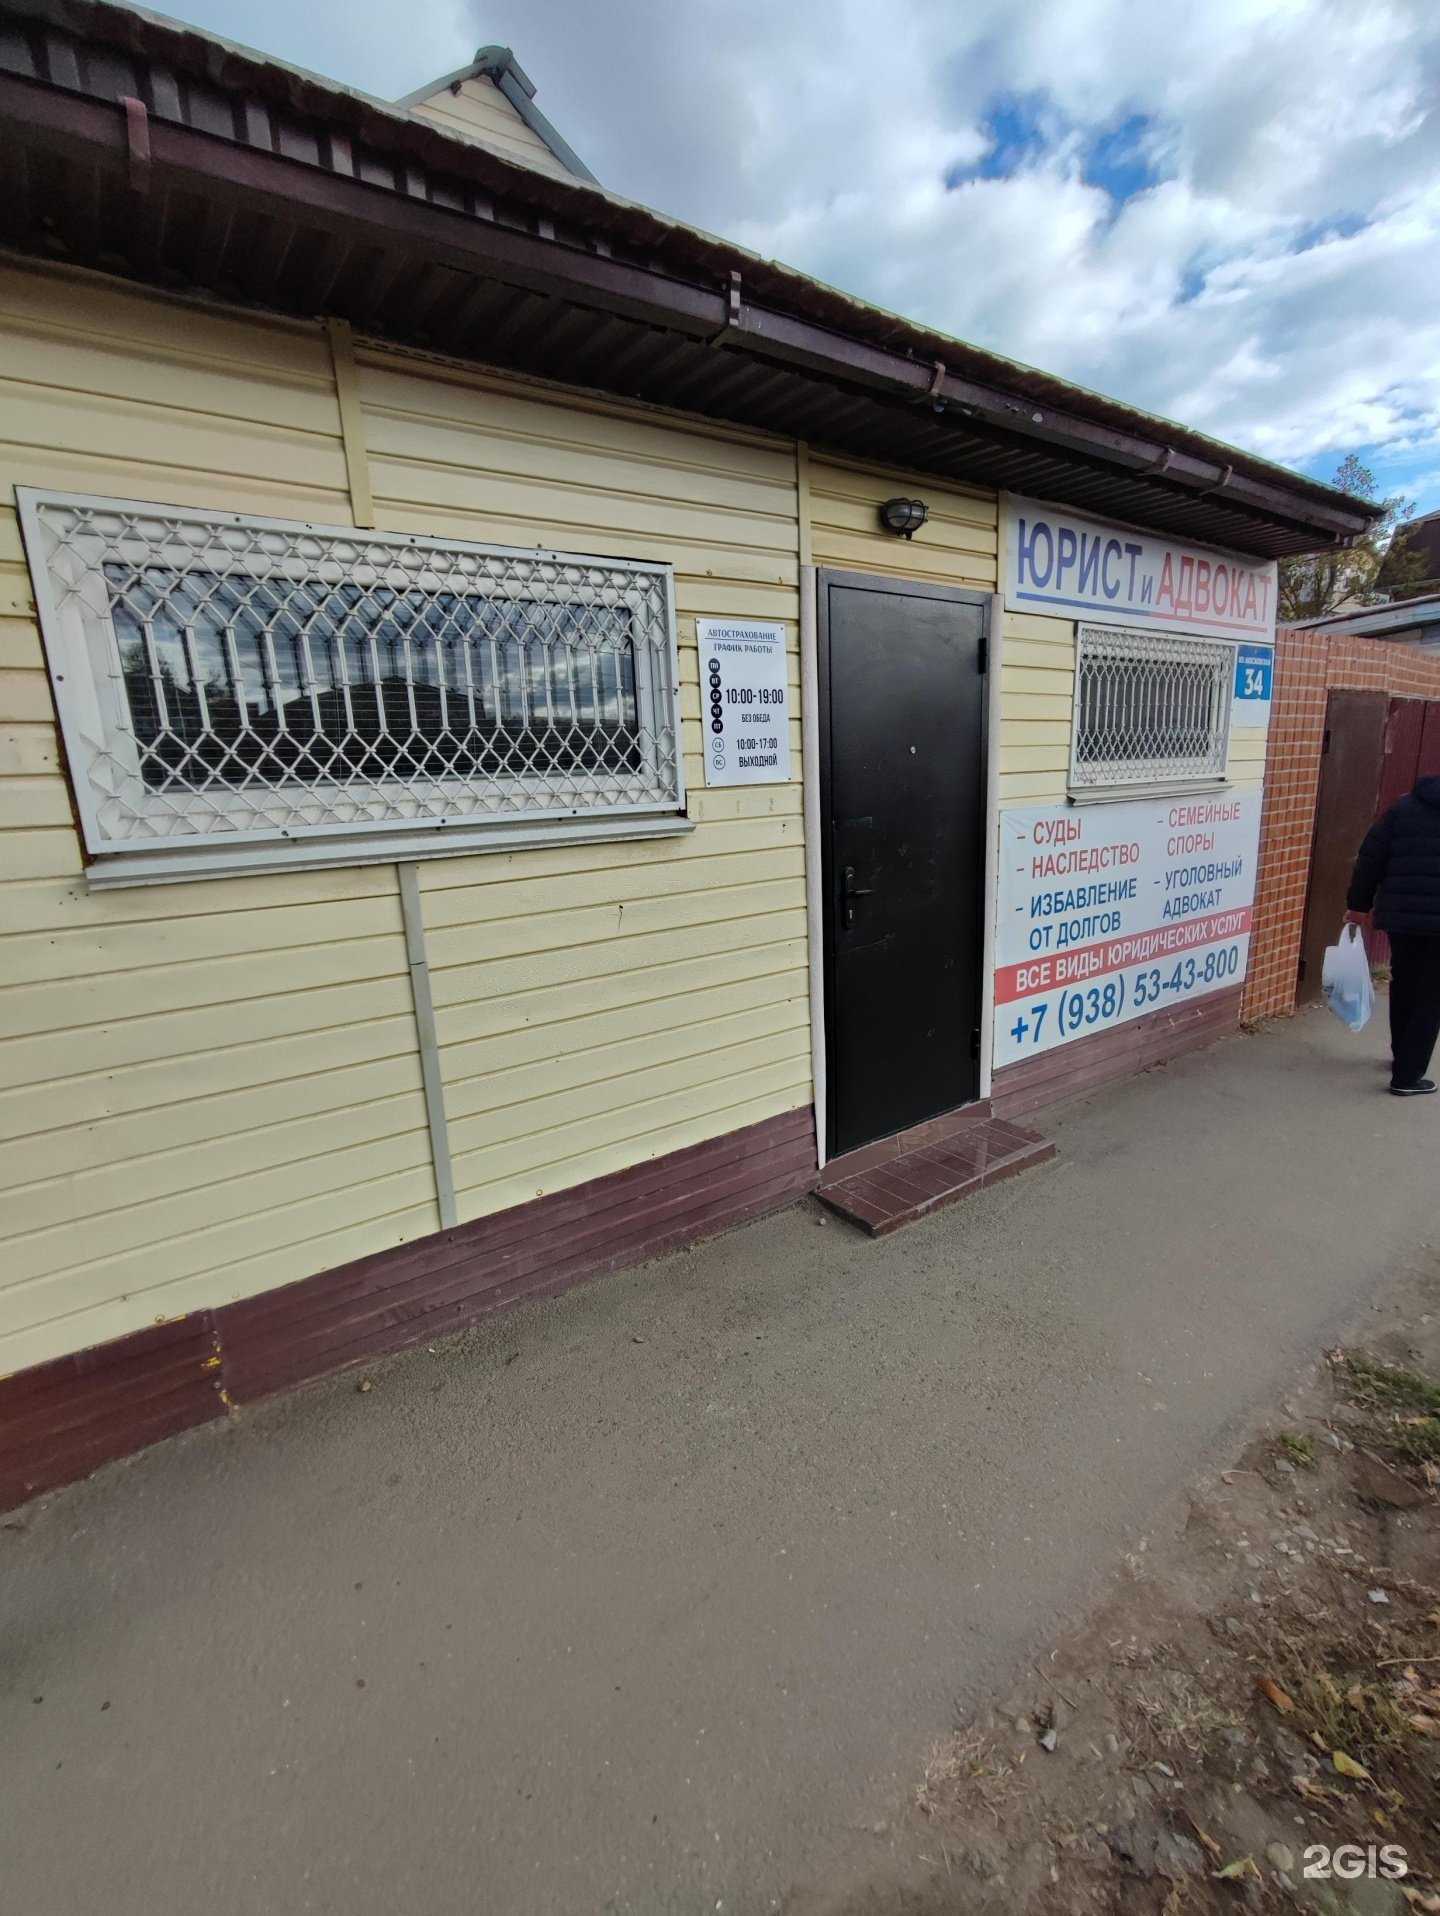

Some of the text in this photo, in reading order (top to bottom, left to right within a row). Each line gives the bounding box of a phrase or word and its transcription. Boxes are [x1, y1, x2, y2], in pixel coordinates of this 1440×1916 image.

[1017, 518, 1143, 602] ЮРИСТ
[1156, 551, 1272, 623] АДВОКАТ
[707, 628, 777, 641] АВТОСТРАХОВАНИЕ
[714, 643, 773, 654] ГРАФИК РАБОТЫ
[1244, 669, 1264, 695] 34
[741, 713, 771, 723] БЕЗ ОБЕДА
[738, 754, 778, 768] ВЫХОДНОЙ
[1168, 800, 1241, 828] СЕМЕЙНЫЕ
[1033, 818, 1081, 848] СУДЫ
[1167, 832, 1215, 856] СПОРЫ
[1031, 842, 1140, 879] НАСЛЕДСТВО
[1164, 855, 1242, 890] УГОЛОВНЫЙ
[1030, 878, 1137, 918] ИЗБАВЛЕНИЕ
[1162, 888, 1222, 919] АДВОКАТ
[1029, 911, 1121, 950] ОТ ДОЛГОВ
[1016, 911, 1246, 992] ВСЕ ВИДЫ ЮРИДИЧЕСКИХ УСЛУГ
[1011, 945, 1239, 1043] +7 (938) 53-43-800
